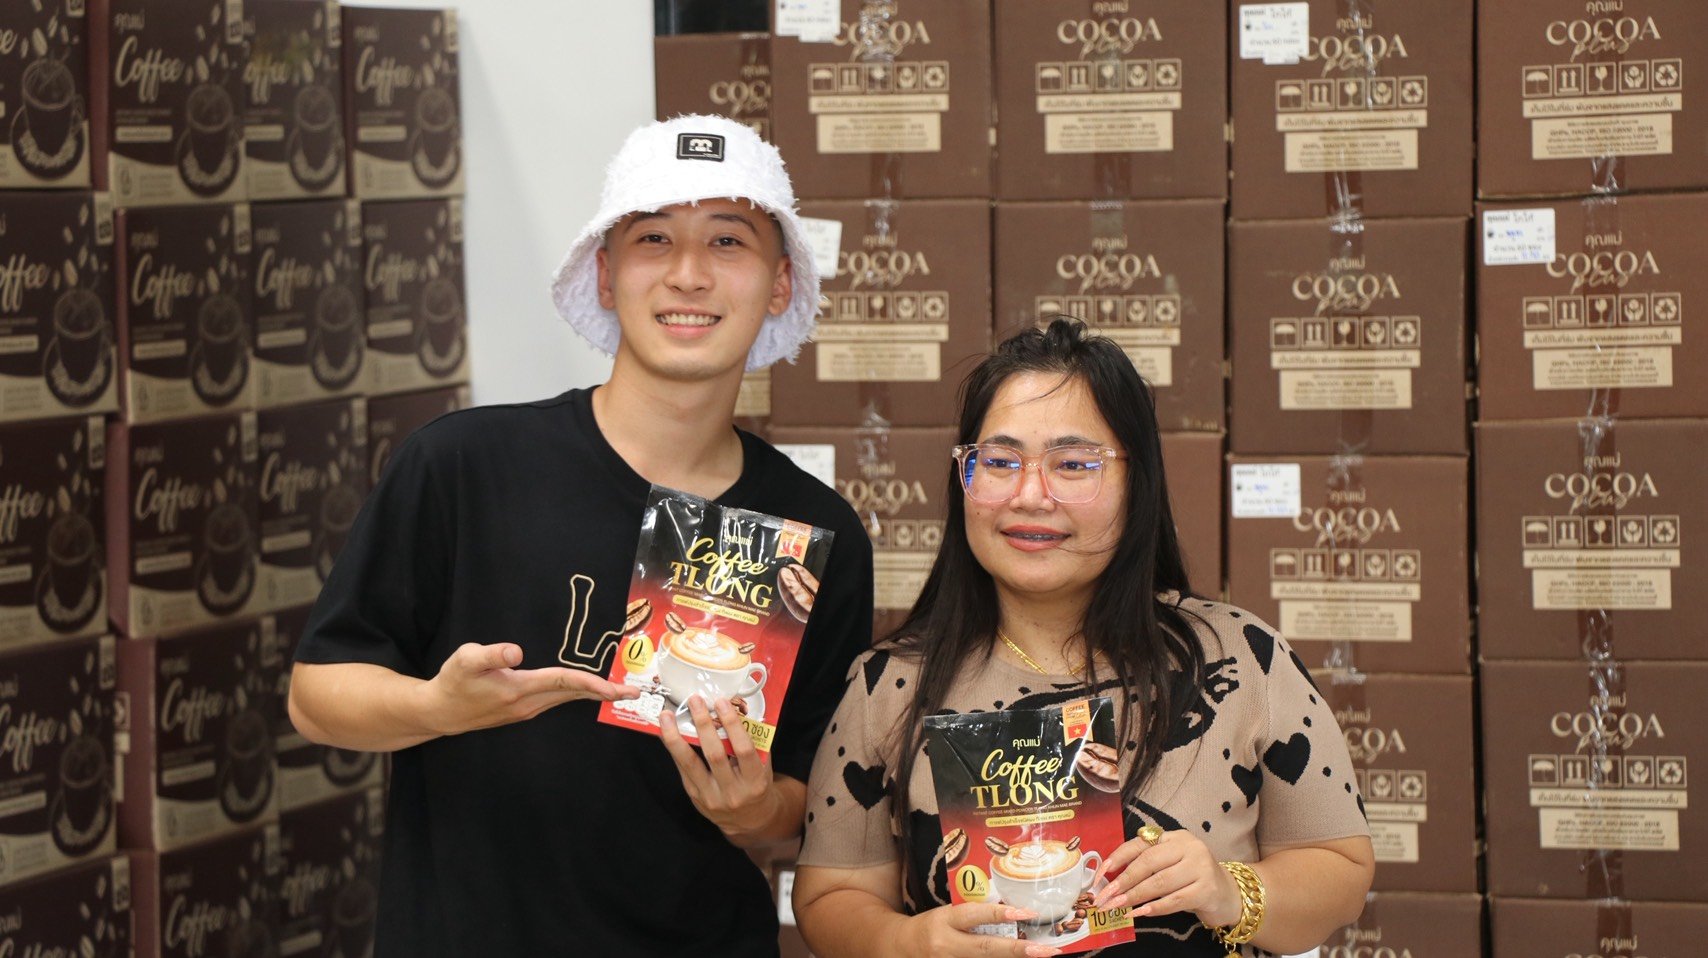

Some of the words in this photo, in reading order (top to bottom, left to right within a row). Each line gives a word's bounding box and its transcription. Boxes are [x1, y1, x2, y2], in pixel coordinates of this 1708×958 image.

[1056, 17, 1163, 44] COCOA
[1545, 16, 1662, 46] COCOA
[115, 35, 185, 103] Coffee
[242, 53, 290, 104] offee
[1056, 254, 1162, 279] COCOA
[1546, 250, 1660, 278] COCOA
[132, 253, 194, 319] Coffee
[1292, 274, 1401, 300] COCOA
[836, 479, 928, 504] OCOA
[1544, 472, 1659, 498] COCOA
[1293, 507, 1400, 533] COCOA
[686, 537, 769, 581] Coffee
[670, 561, 773, 609] TLONG
[1551, 712, 1665, 738] COCOA
[1012, 736, 1041, 751] คุณแม่
[1343, 727, 1407, 753] COA
[981, 748, 1060, 788] Coffee
[970, 776, 1080, 809] TLONG
[1091, 910, 1107, 927] 10
